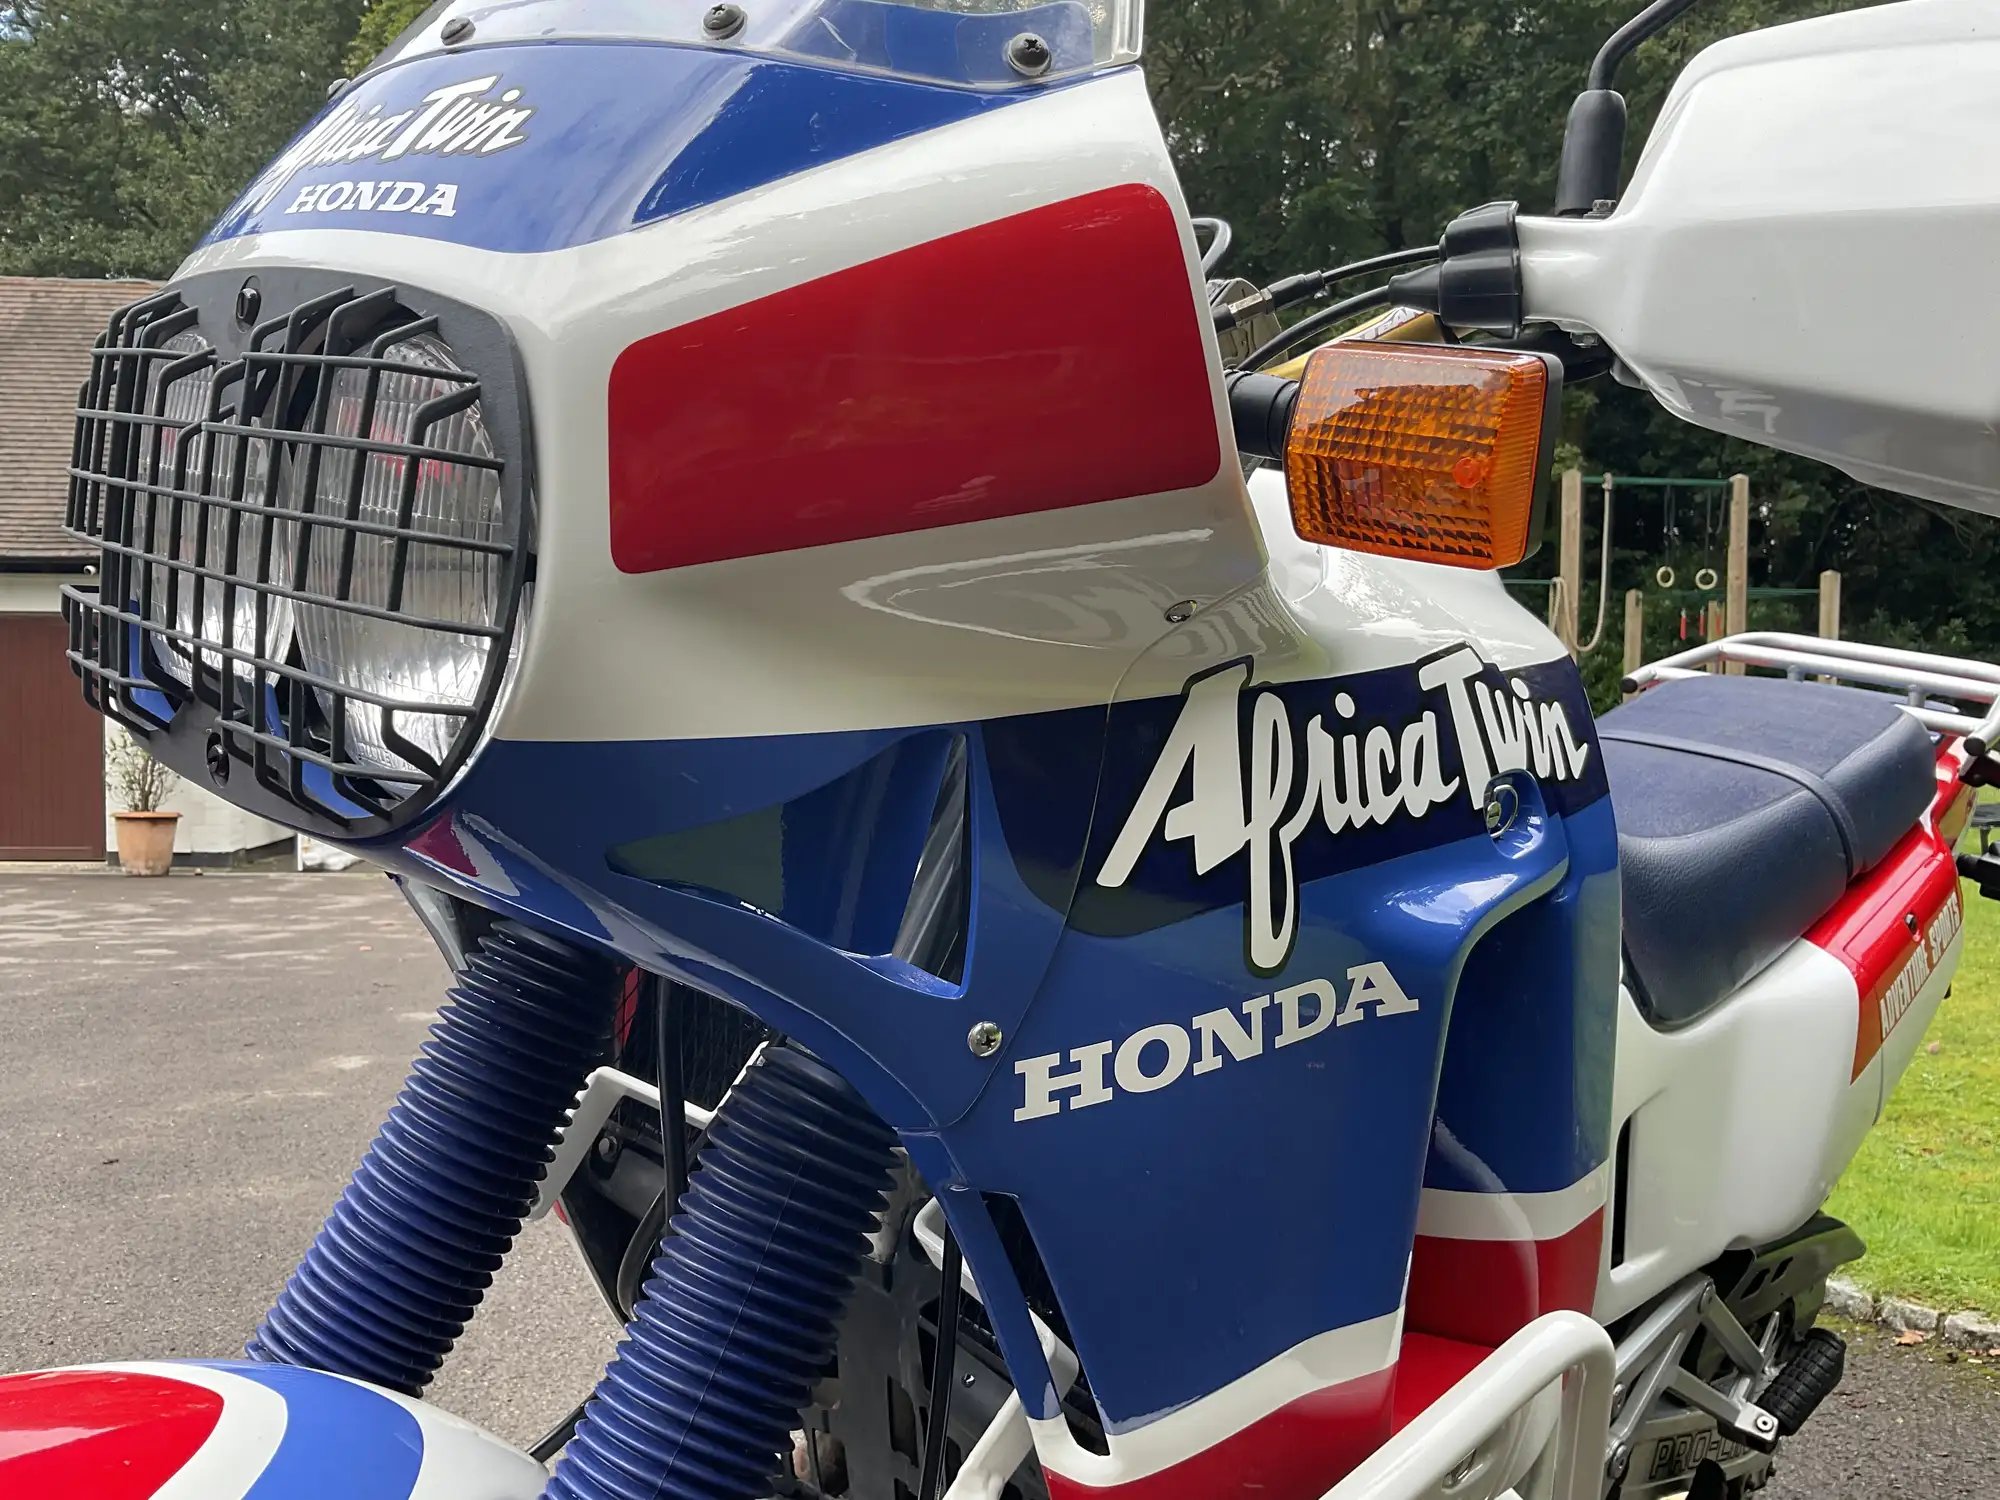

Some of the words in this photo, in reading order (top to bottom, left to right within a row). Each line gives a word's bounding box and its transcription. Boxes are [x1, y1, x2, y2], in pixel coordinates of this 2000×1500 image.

[384, 74, 534, 160] Twin
[285, 181, 459, 217] HONDA
[1096, 662, 1460, 968] Africa
[1420, 648, 1588, 810] Twin
[1880, 938, 1930, 1039] ADVENTURE
[1928, 891, 1961, 964] SPORTS
[1014, 961, 1419, 1122] HONDA
